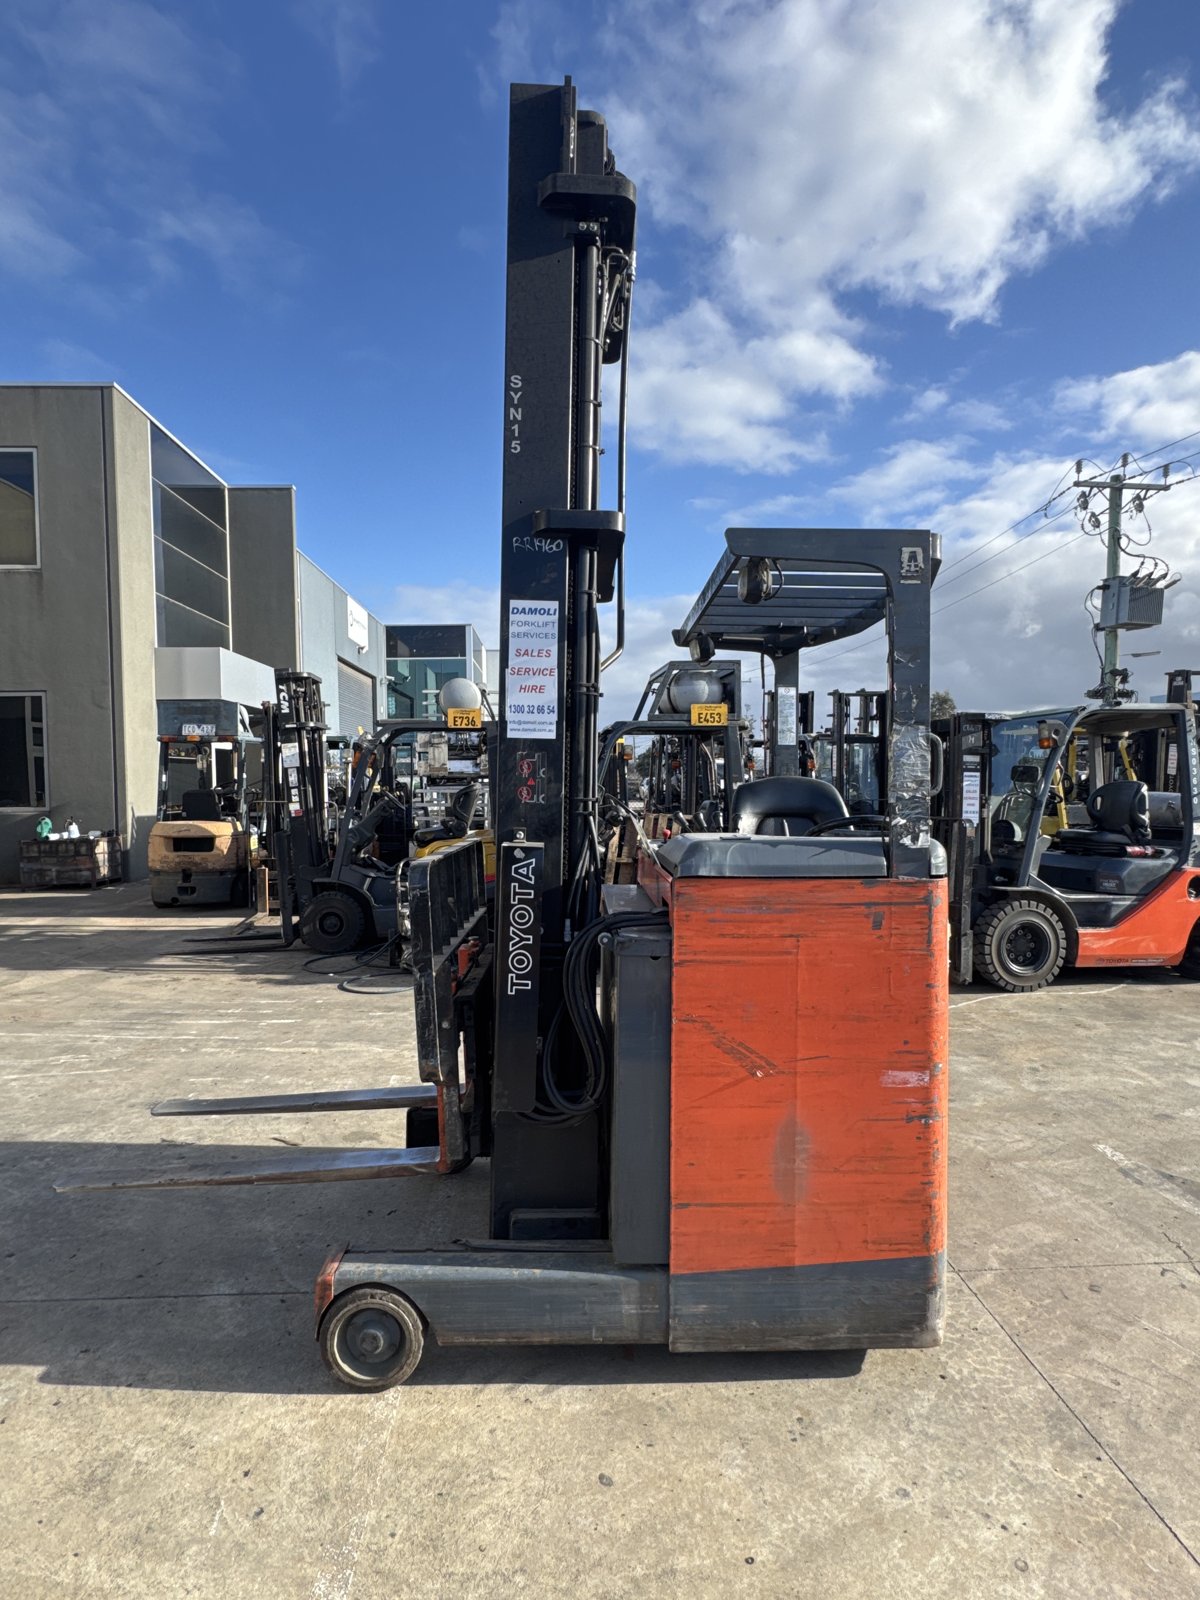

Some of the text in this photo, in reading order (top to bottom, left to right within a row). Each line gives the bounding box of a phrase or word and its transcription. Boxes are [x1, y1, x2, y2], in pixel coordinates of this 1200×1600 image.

[510, 375, 522, 453] SYN15
[511, 606, 557, 616] DAMOLI
[510, 620, 556, 629] FORKLIFT
[510, 631, 557, 640] SERVICES
[514, 648, 552, 658] SALES
[509, 667, 556, 677] SERVICE
[518, 684, 546, 694] HIRE
[279, 685, 290, 713] TCM
[508, 704, 525, 714] 1300
[526, 704, 535, 714] 32
[546, 705, 556, 715] 54
[453, 716, 476, 727] E736
[697, 712, 722, 724] E453
[508, 858, 536, 995] TOYOTA
